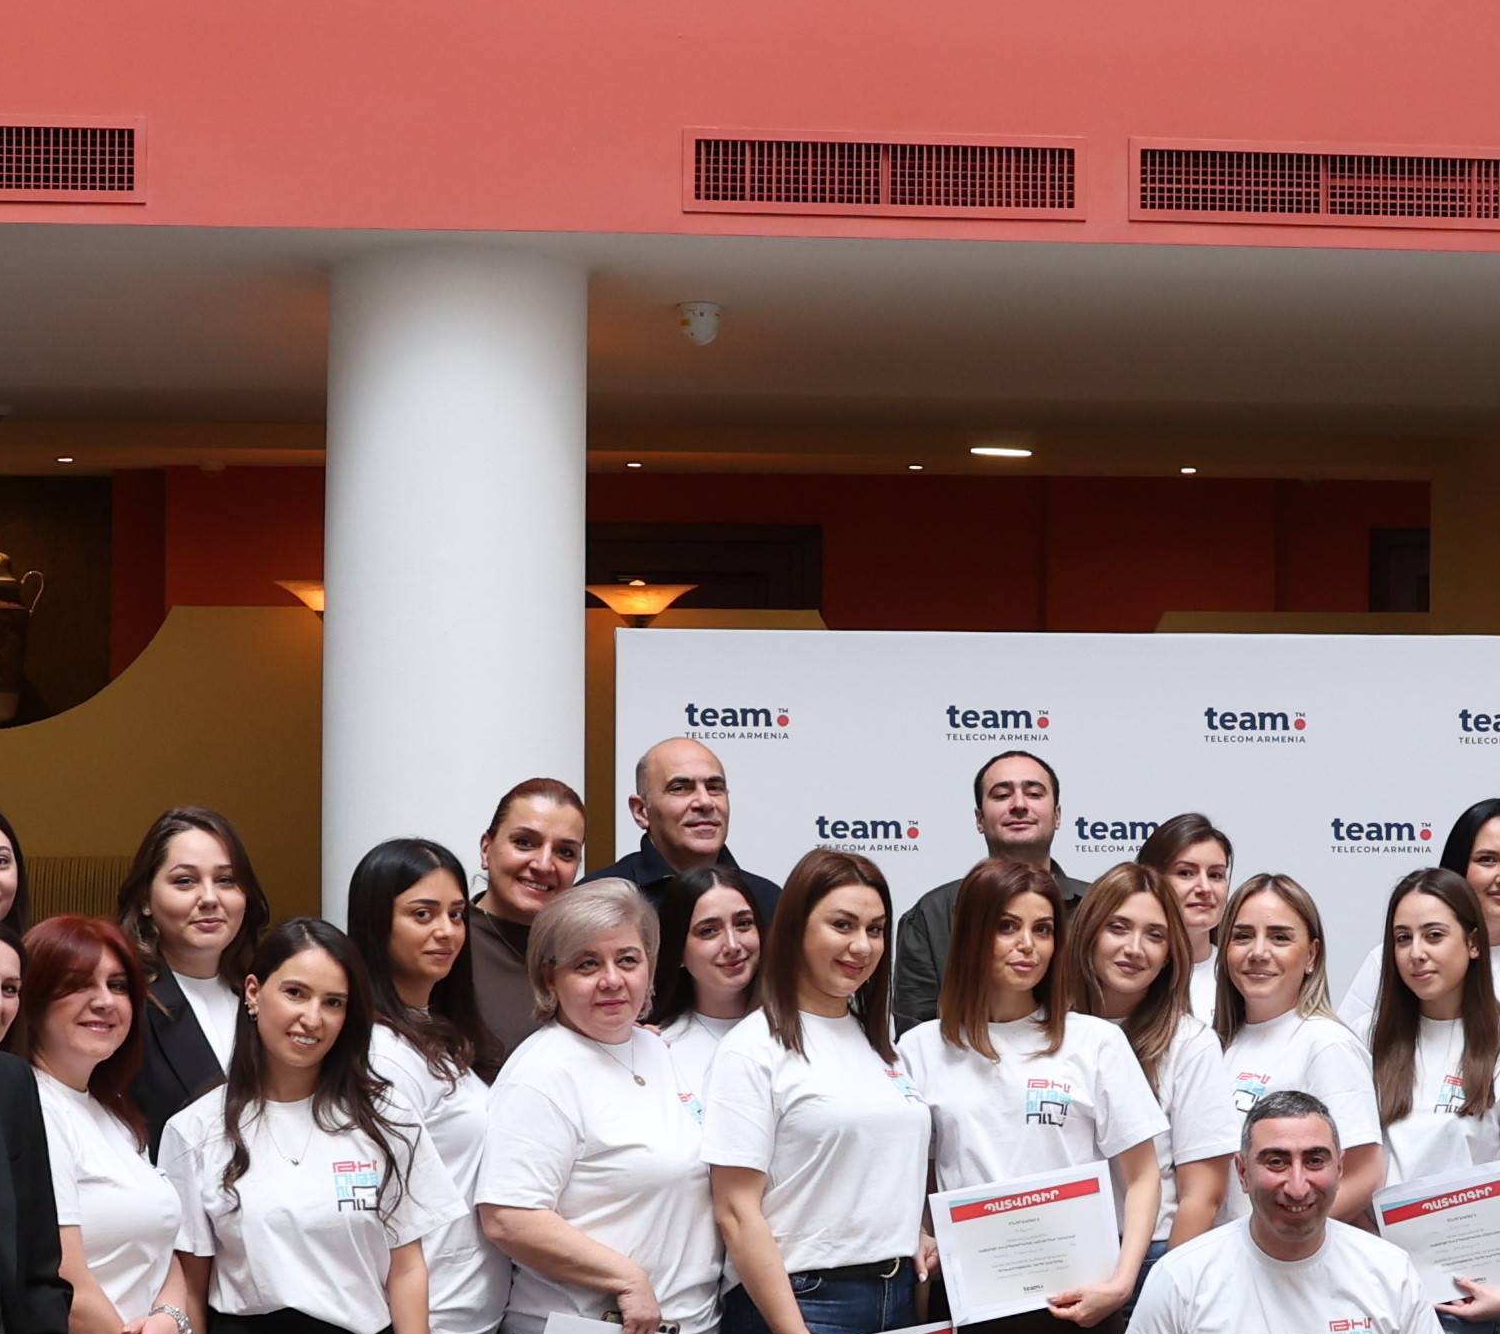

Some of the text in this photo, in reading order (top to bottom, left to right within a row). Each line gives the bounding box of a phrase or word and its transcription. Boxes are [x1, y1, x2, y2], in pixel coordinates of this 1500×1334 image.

[685, 703, 772, 727] team
[946, 705, 1032, 729] team
[1204, 707, 1290, 731] team
[685, 732, 789, 740] TELECOM ARMENIA
[946, 733, 1050, 741] TELECOM ARMENIA
[1204, 735, 1306, 743] TELECOM ARMENIA
[815, 816, 902, 839] team
[1075, 817, 1159, 840] team
[1331, 818, 1415, 841] team
[869, 844, 919, 852] ARMENIA
[1075, 845, 1125, 853] TELECOM
[1382, 846, 1432, 854] ARMENIA
[983, 1189, 1060, 1212] ՊԱՏՎՈԳԻՐ
[1421, 1186, 1493, 1211] ՊԱՏՎՈԳԻՐ
